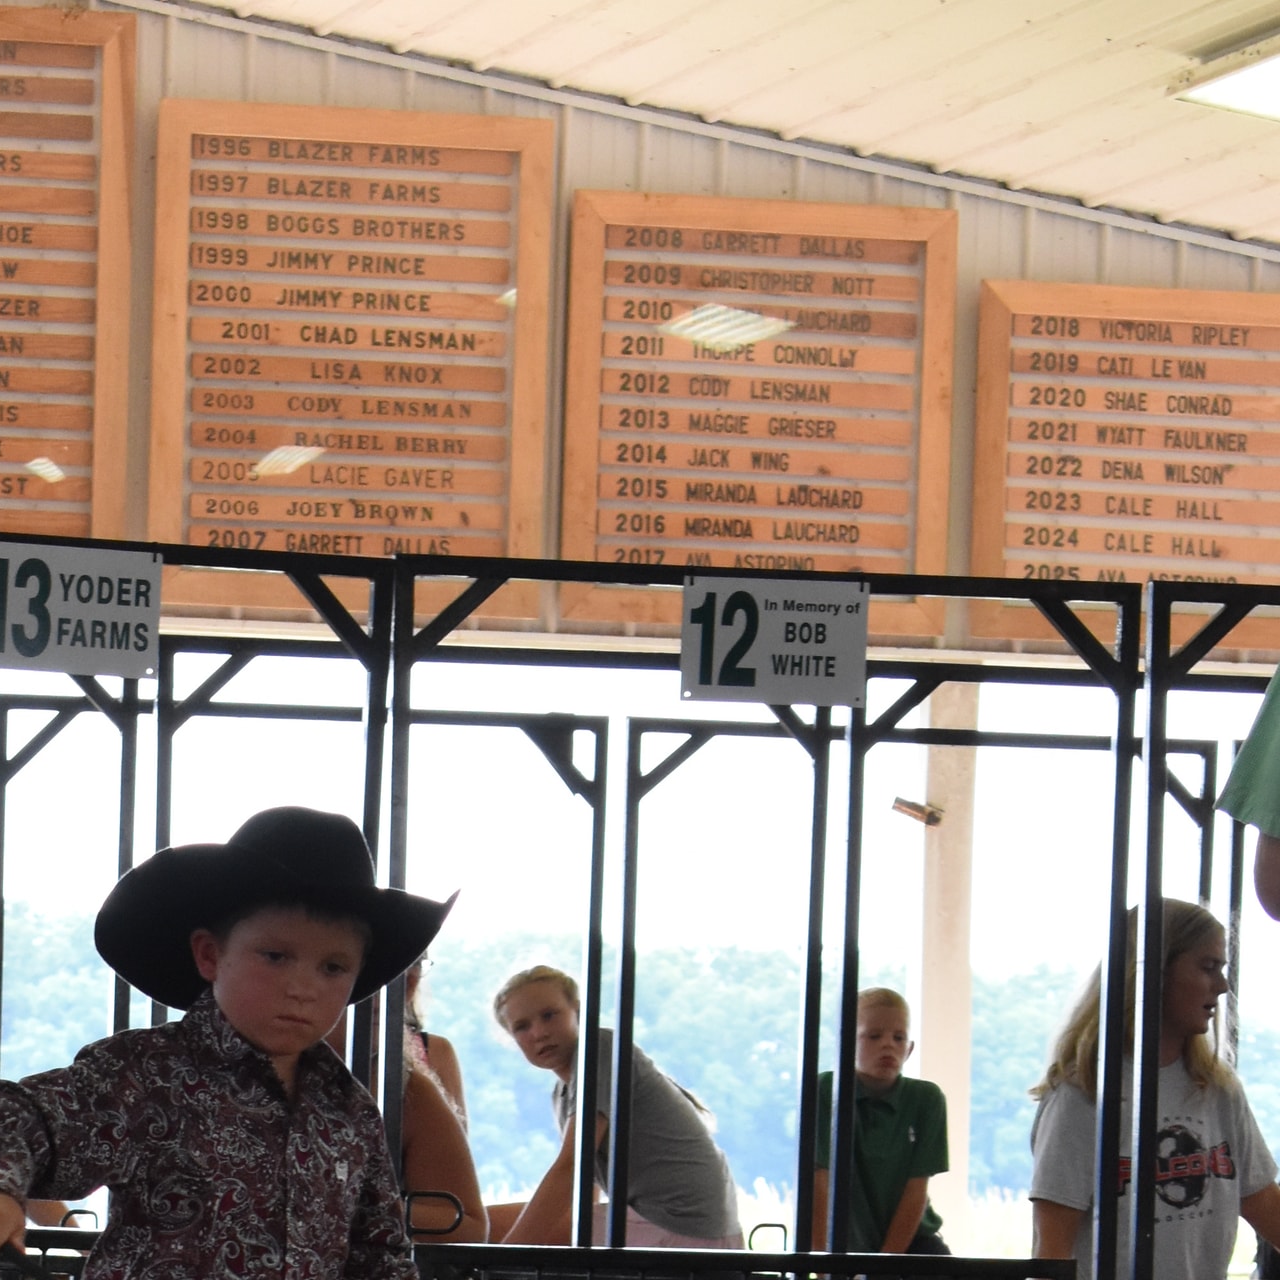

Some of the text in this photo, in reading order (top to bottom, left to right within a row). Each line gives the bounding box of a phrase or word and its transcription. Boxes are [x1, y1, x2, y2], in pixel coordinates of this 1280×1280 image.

[199, 137, 440, 166] 1996 BLAZER FARMS
[197, 174, 440, 203] 1997 BLAZER FARMS
[197, 211, 465, 241] 1998 BOGGS BROTHERS
[196, 247, 425, 275] 1999 JIMMY PRINCE
[624, 265, 875, 296] 2009 CHRISTOPHER NOTT
[196, 285, 431, 312] 2000 JIMMY PRINCE
[222, 321, 476, 351] 2001 CHAD LENSMAN
[621, 336, 664, 355] 2011
[1031, 316, 1251, 346] 2018 VICTORIA RIPLEY
[204, 356, 443, 384] 2002 LISA KNOX
[620, 373, 831, 402] 2012 CODY LENSMAN
[1030, 387, 1232, 416] 2020 SHAE CONRAD
[204, 392, 473, 418] 2003 CODY LENSMAN
[619, 409, 836, 439] 2013 MAGGIE GRIESER
[1028, 422, 1247, 452] 2021 WYATT FAULKNER
[205, 428, 468, 455] 2004 RACHEL BERRY
[617, 444, 790, 471] 2014 JACK WING
[1026, 456, 1224, 485] 2022 DENA WILSON
[617, 478, 863, 509] 2015 MIRANDA LAUCHARD
[1026, 491, 1223, 521] 2023 CALE HALL
[206, 499, 433, 521] 2006 JOEY BROWN
[616, 514, 860, 543] 2016 MIRANDA LAUCHARD
[1024, 527, 1221, 558] 2024 CALE HALL
[59, 573, 151, 607] YODER
[765, 599, 860, 615] In Memory of
[57, 618, 149, 652] FARMS
[690, 590, 759, 687] 12
[784, 622, 827, 644] BOB
[772, 654, 836, 677] WHITE
